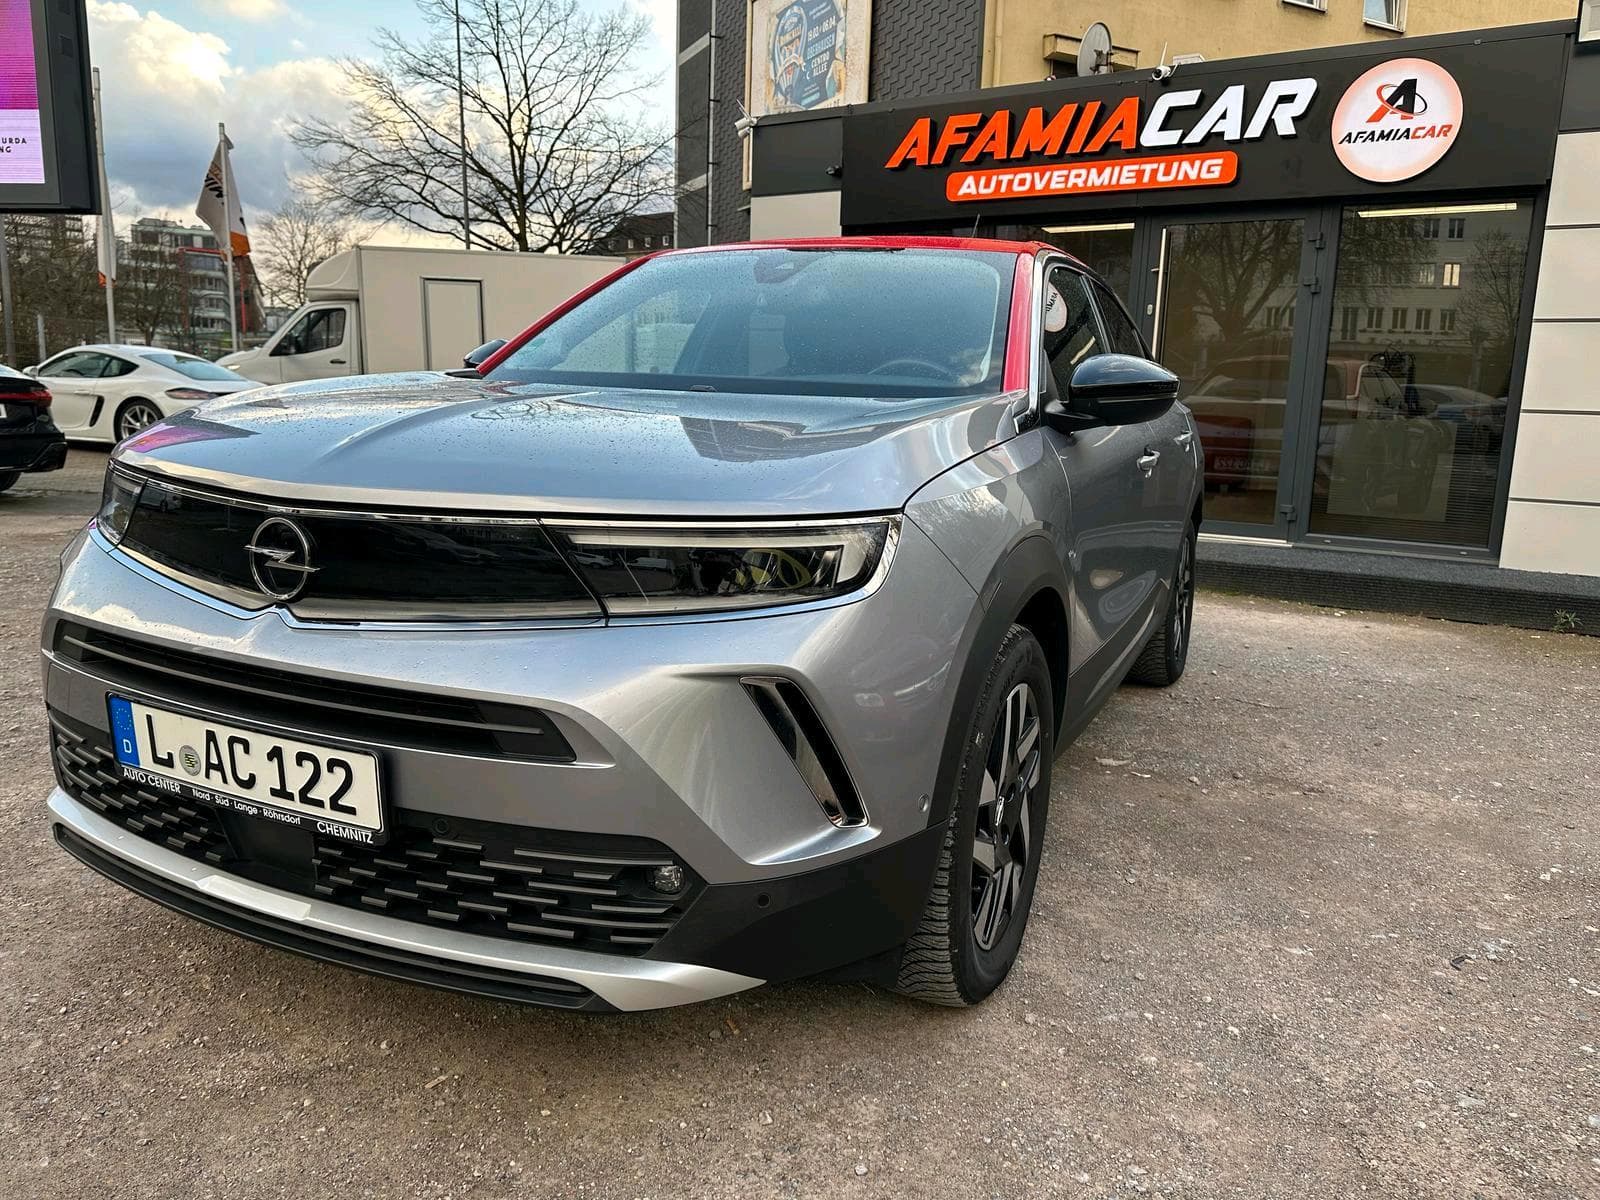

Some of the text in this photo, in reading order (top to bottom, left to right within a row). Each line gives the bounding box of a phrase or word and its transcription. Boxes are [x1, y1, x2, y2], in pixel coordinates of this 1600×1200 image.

[884, 77, 1318, 169] AFAMIACAR
[1338, 124, 1453, 145] AFAMIACAR
[957, 157, 1225, 197] AUTOVERMIETUNG
[123, 738, 132, 754] D
[145, 714, 357, 816] L AC 122
[123, 768, 146, 784] AUTO
[147, 775, 182, 795] CENTER
[192, 788, 211, 801] Nord
[214, 795, 230, 807] Süd
[233, 801, 259, 816] Lange
[316, 821, 374, 844] CHEMNITZ
